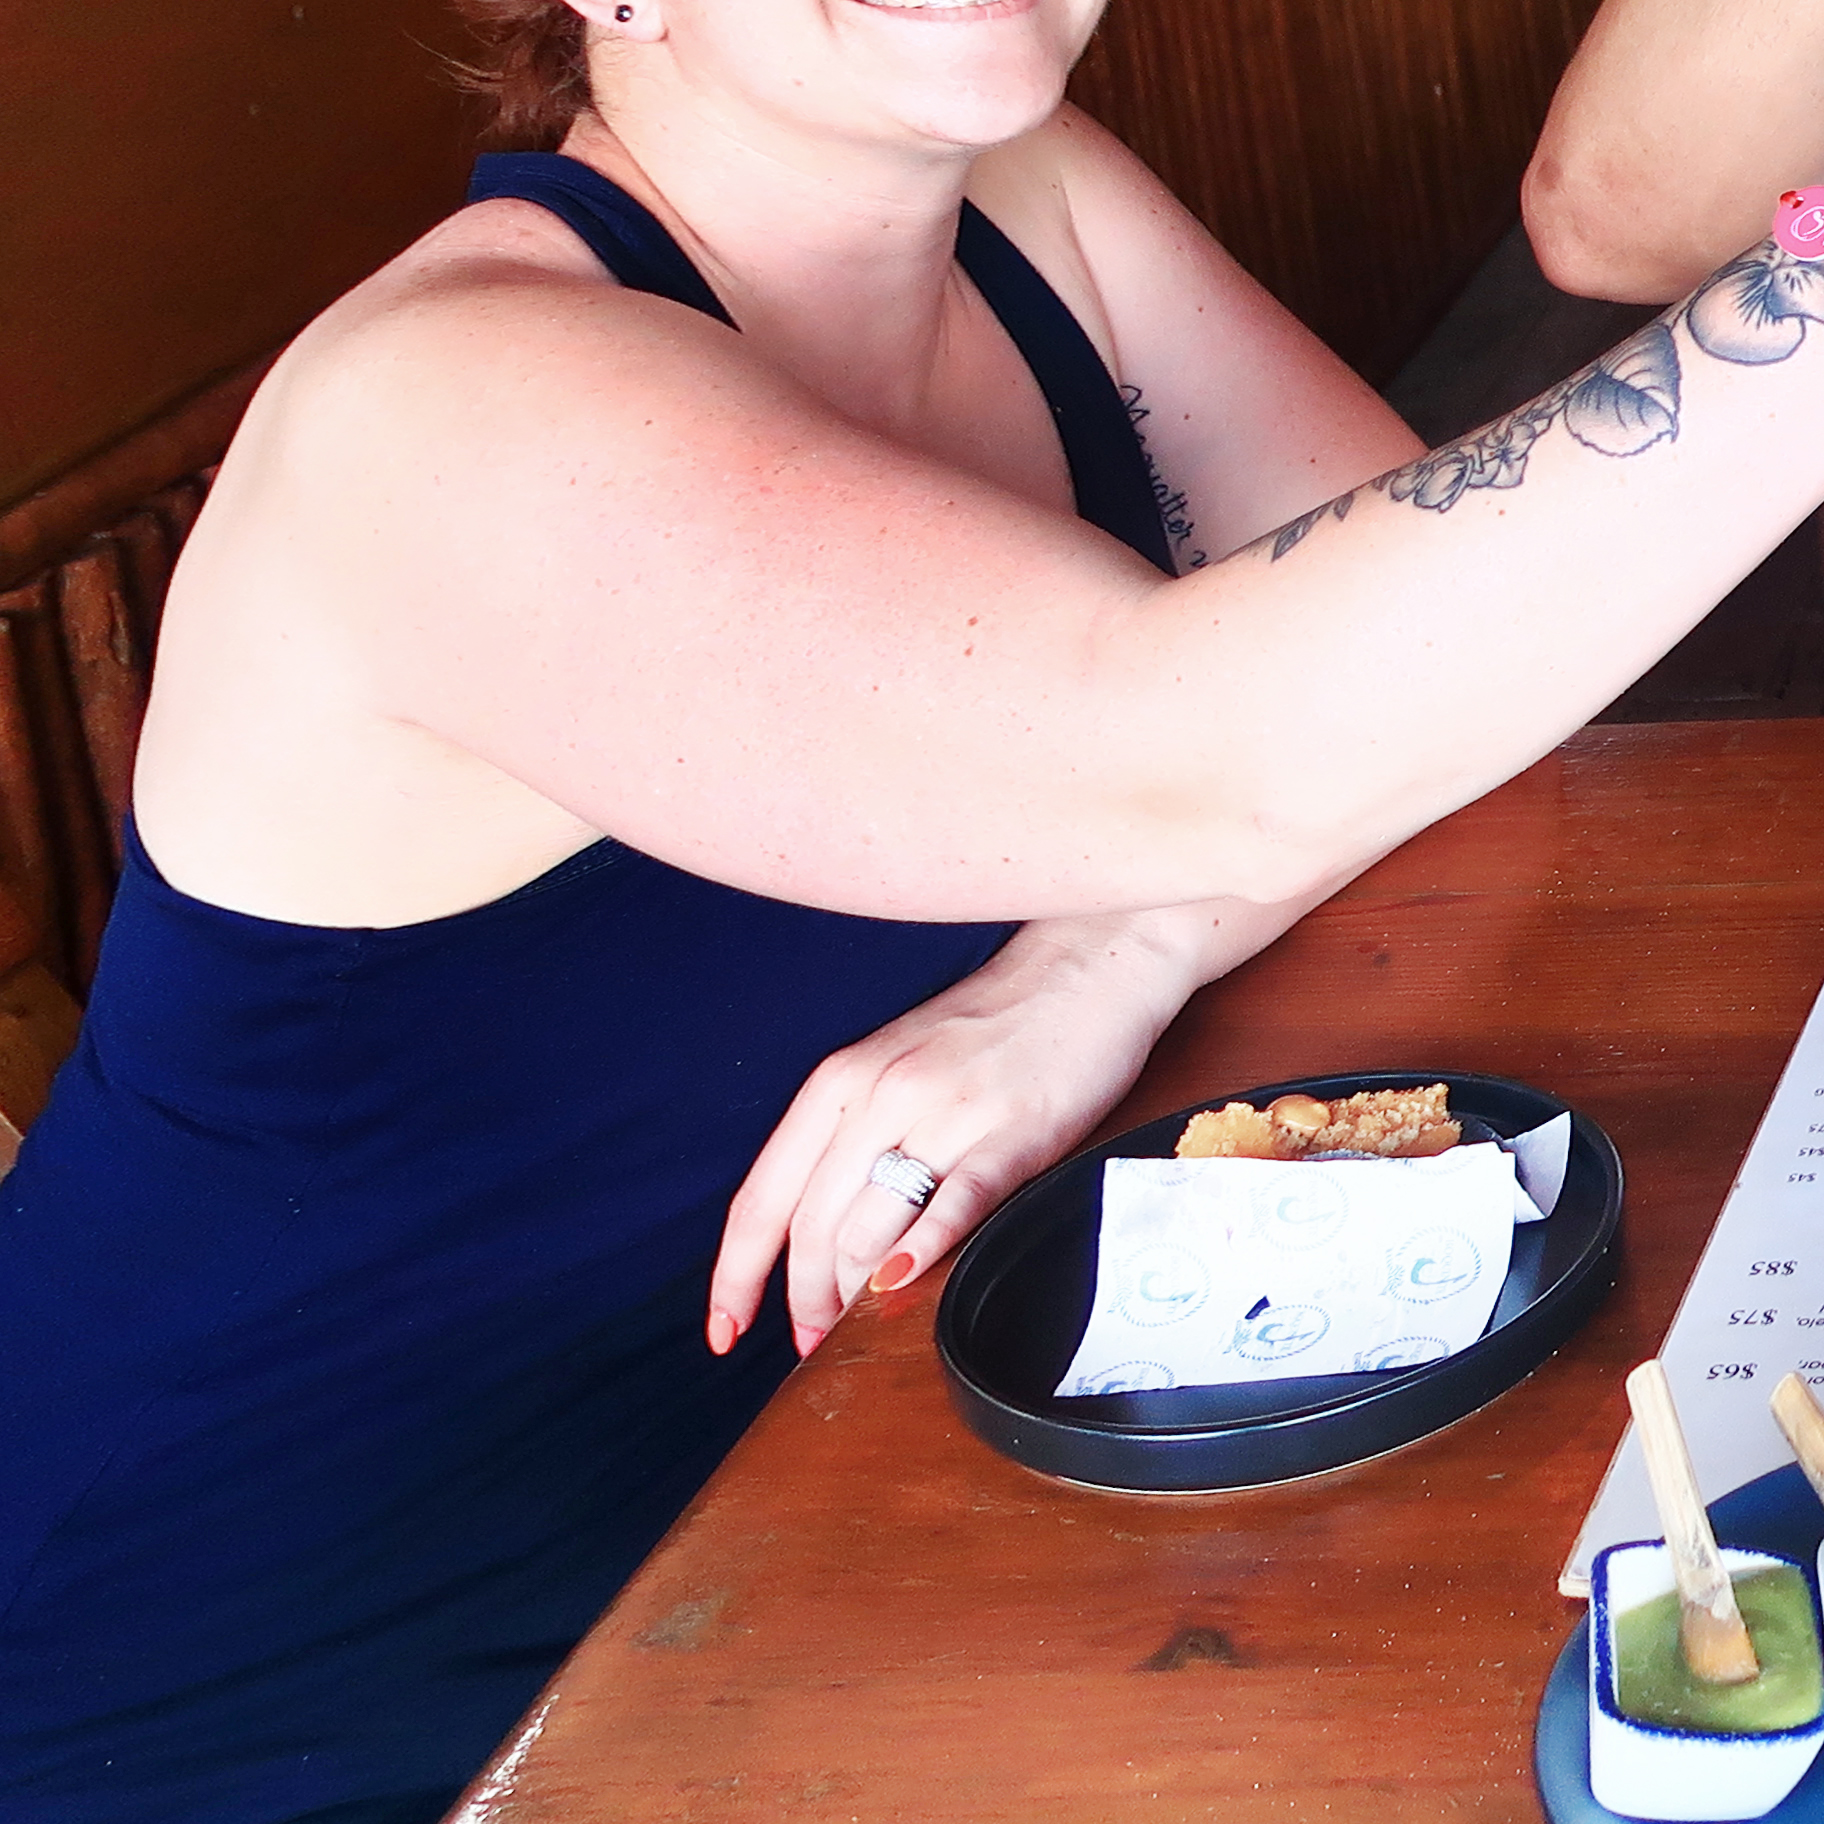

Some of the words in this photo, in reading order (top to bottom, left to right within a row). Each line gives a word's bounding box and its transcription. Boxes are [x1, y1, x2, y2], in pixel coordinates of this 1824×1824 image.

[1749, 1260, 1798, 1276] $85
[1728, 1308, 1778, 1326] $75
[1707, 1363, 1758, 1380] $65
